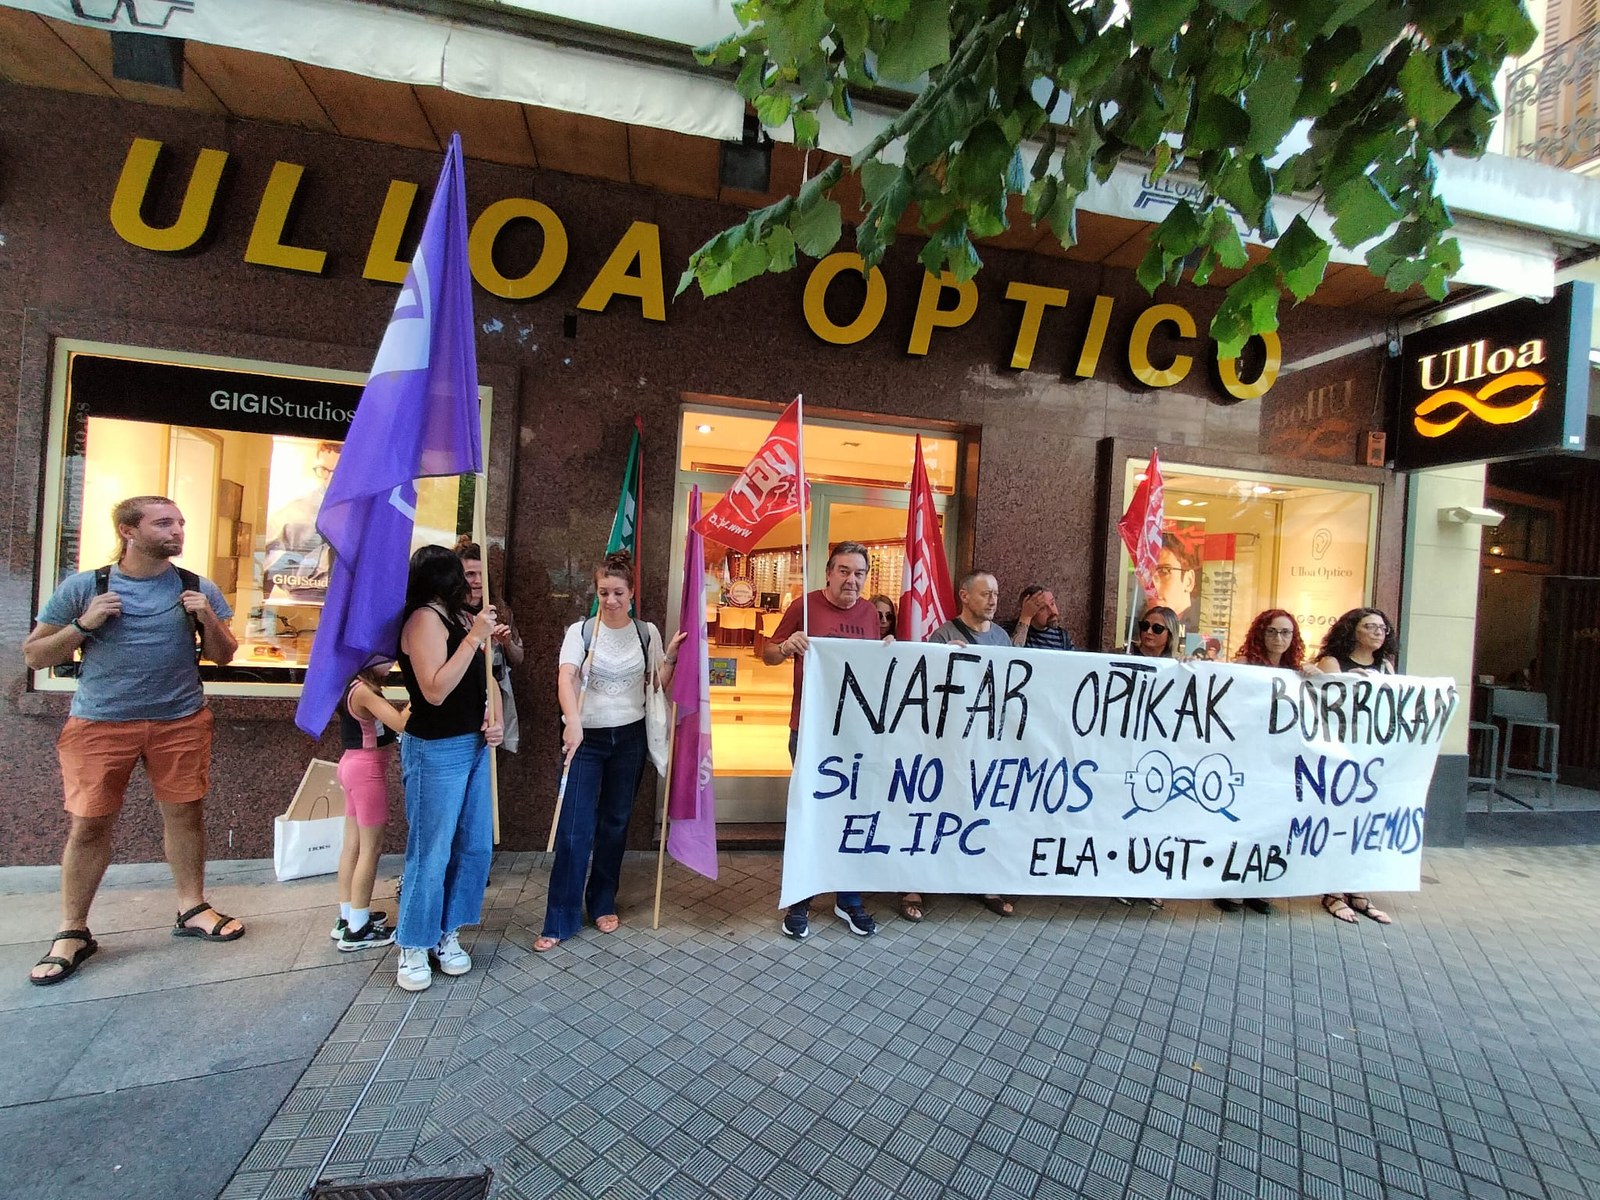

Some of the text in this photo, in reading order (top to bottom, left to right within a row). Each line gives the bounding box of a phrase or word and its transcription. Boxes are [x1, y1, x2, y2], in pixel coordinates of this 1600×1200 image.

[110, 137, 666, 321] ULLOA
[803, 251, 1281, 399] OPTICO
[1418, 340, 1546, 390] Ulloa
[273, 574, 329, 587] GIGIStud
[1291, 566, 1353, 580] Ulloa Optico
[832, 652, 1033, 741] NAFAR
[1268, 676, 1459, 746] BORROKAN
[887, 753, 944, 804] NO
[970, 757, 1099, 814] VEMOS
[1294, 754, 1384, 806] NOS
[838, 811, 990, 856] EL IPC
[1029, 835, 1288, 884] ELA UGT LAB
